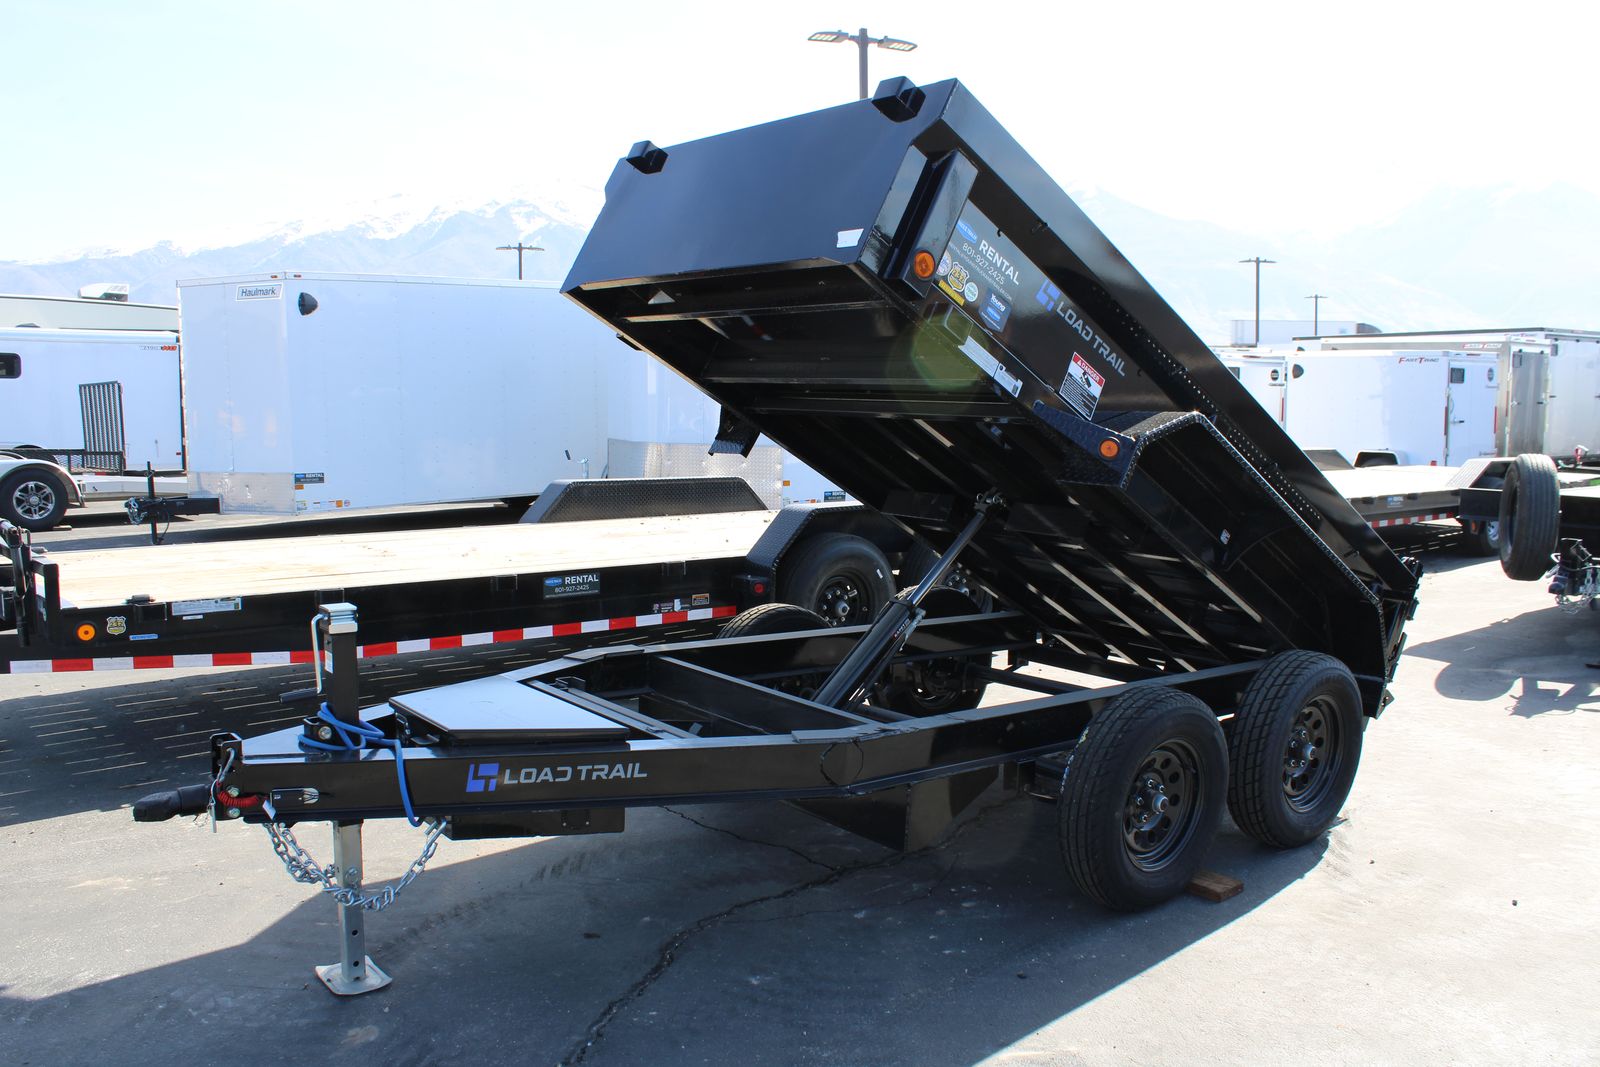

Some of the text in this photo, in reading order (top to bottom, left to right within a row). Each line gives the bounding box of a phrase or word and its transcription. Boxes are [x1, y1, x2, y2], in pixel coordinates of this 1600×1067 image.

[962, 243, 1005, 285] 801-927-2425
[979, 240, 1019, 285] RENTAL
[241, 287, 276, 296] Haulmark
[991, 293, 1006, 312] Young
[1056, 301, 1093, 341] LOAD
[1093, 335, 1125, 376] TRAIL
[1080, 361, 1100, 383] DANGER
[554, 584, 590, 593] 801-927-2425
[564, 574, 599, 585] RENTAL
[503, 766, 573, 785] LOAD
[577, 762, 648, 781] TRAIL
